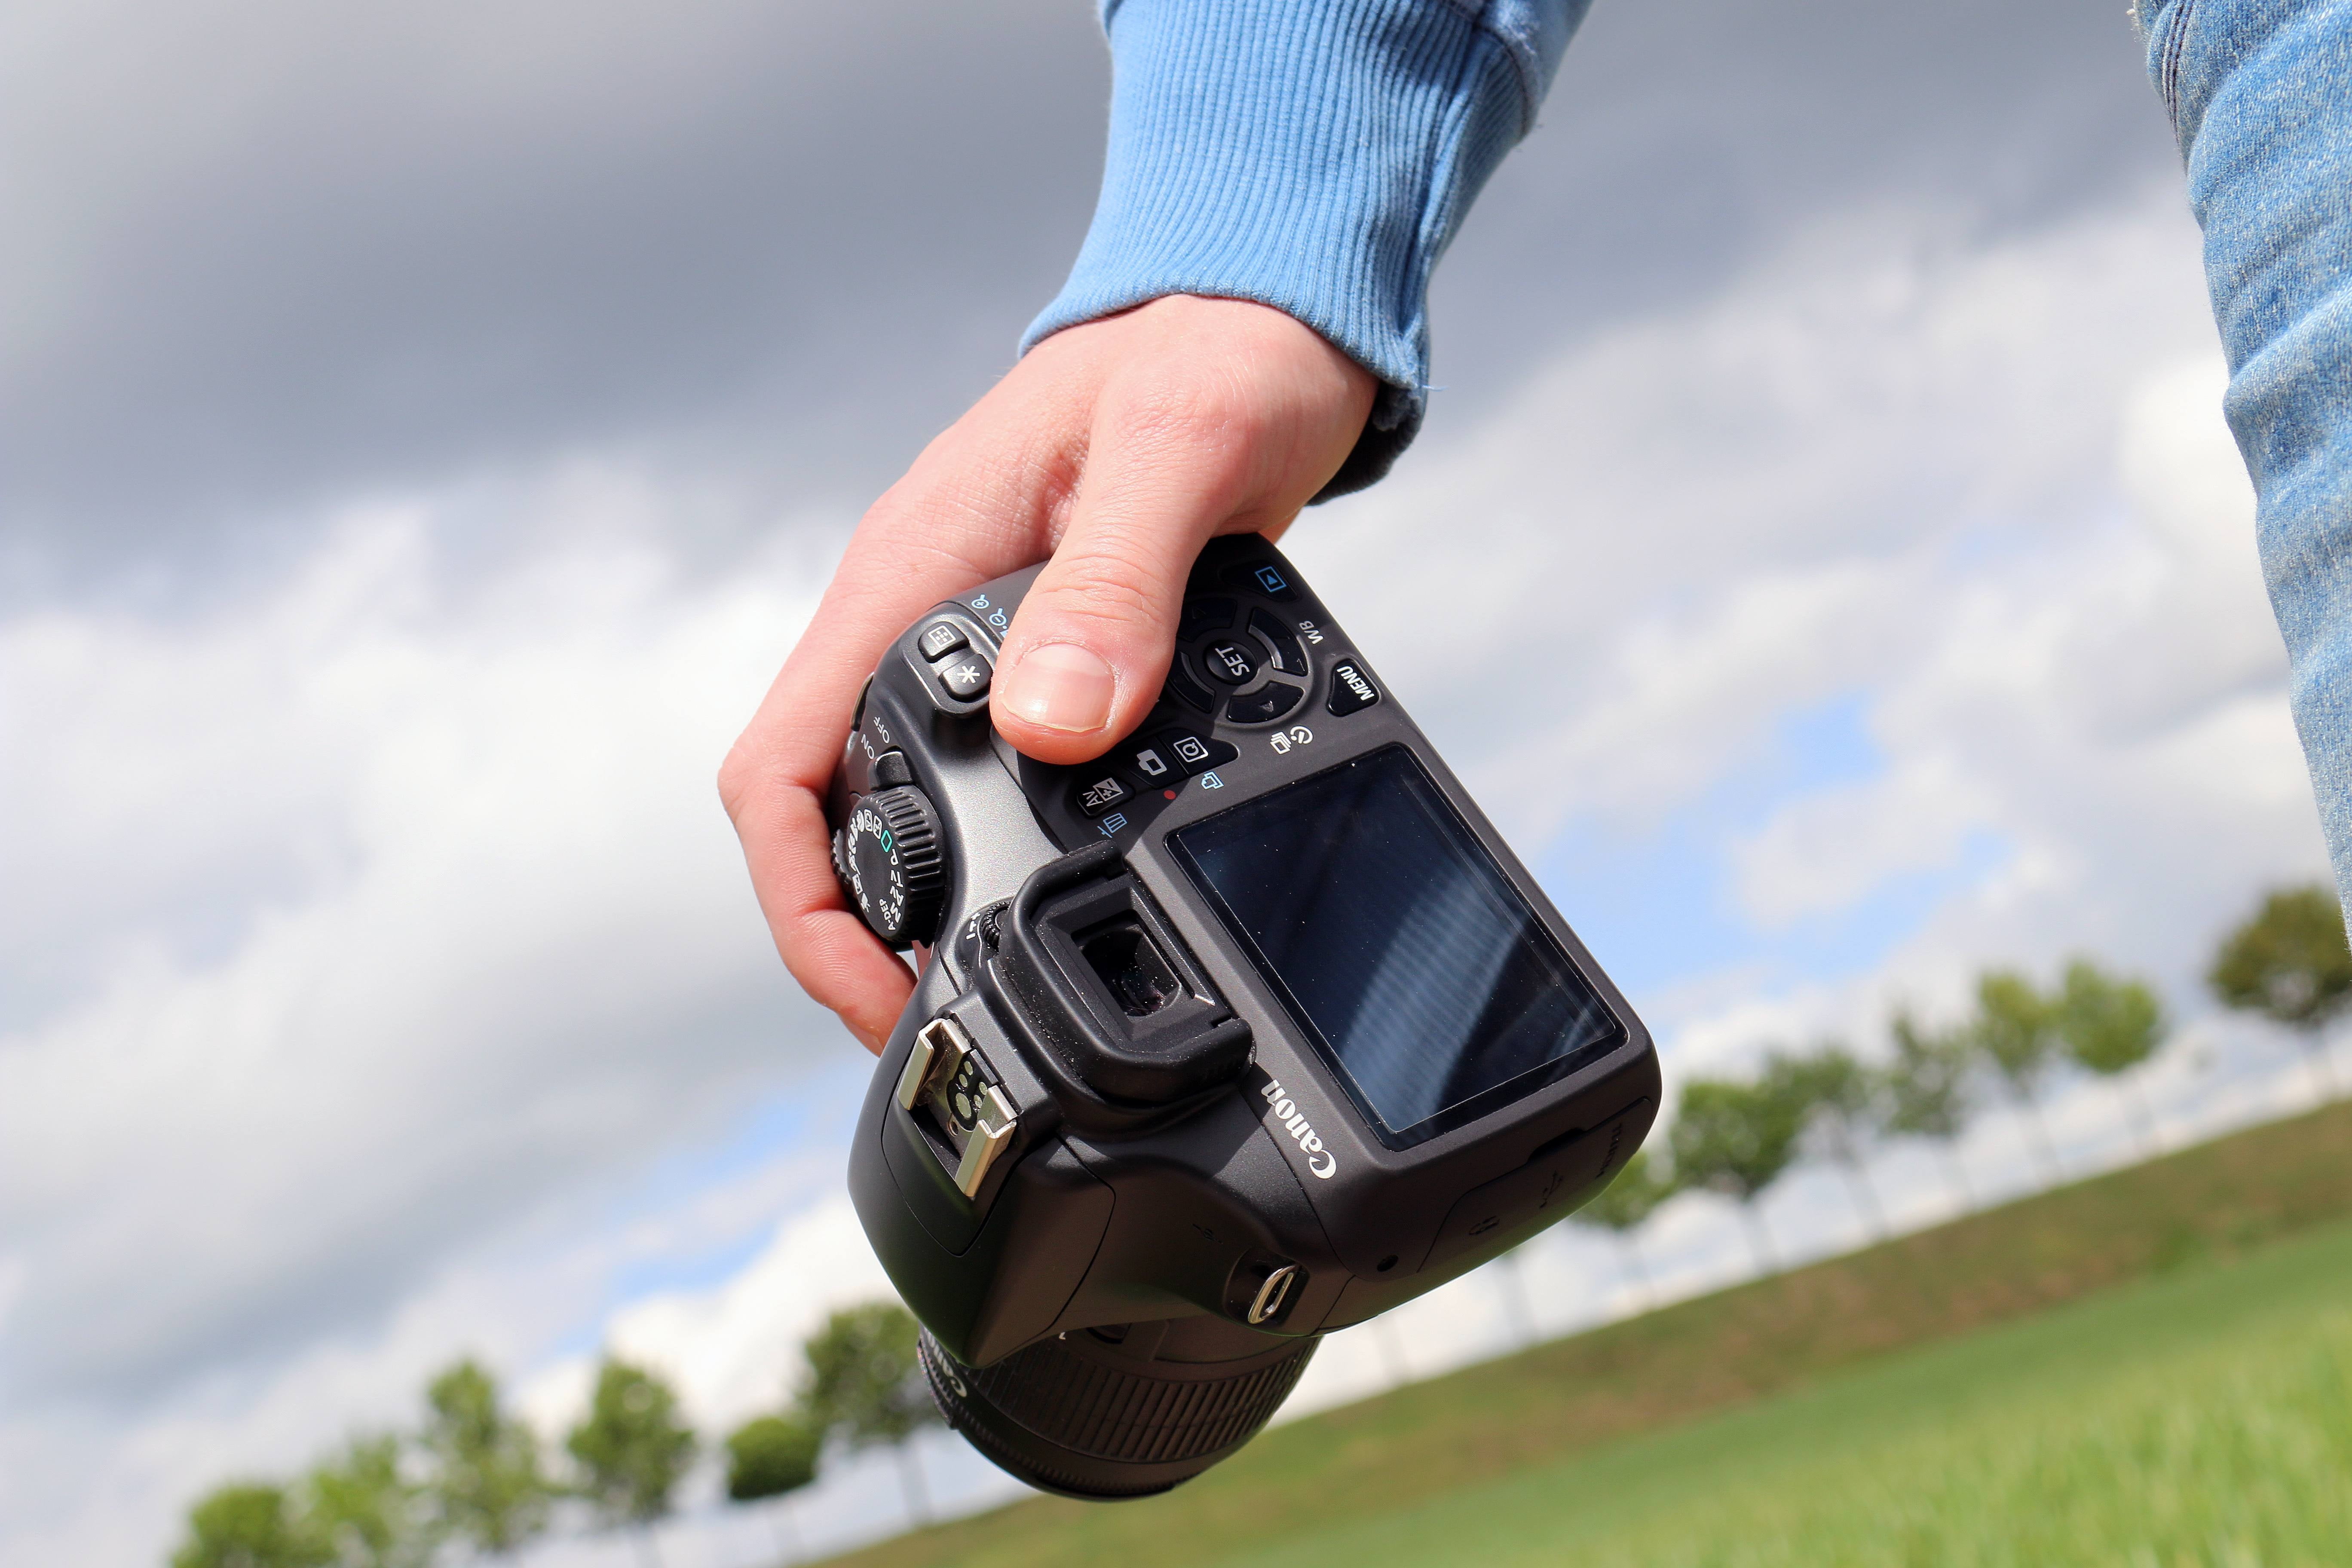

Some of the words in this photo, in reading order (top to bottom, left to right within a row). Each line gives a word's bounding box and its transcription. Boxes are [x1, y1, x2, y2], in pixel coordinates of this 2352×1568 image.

[1299, 621, 1323, 644] WB
[1215, 647, 1250, 676] SET
[1336, 666, 1375, 701] MENU
[873, 717, 890, 744] OFF
[861, 734, 875, 760] ON
[890, 848, 899, 866] P
[890, 870, 903, 888] Tv
[890, 885, 904, 906] Av
[879, 899, 896, 931] A-DEP
[890, 902, 901, 923] M
[1261, 1079, 1336, 1179] Canon
[923, 1326, 967, 1397] Cano
